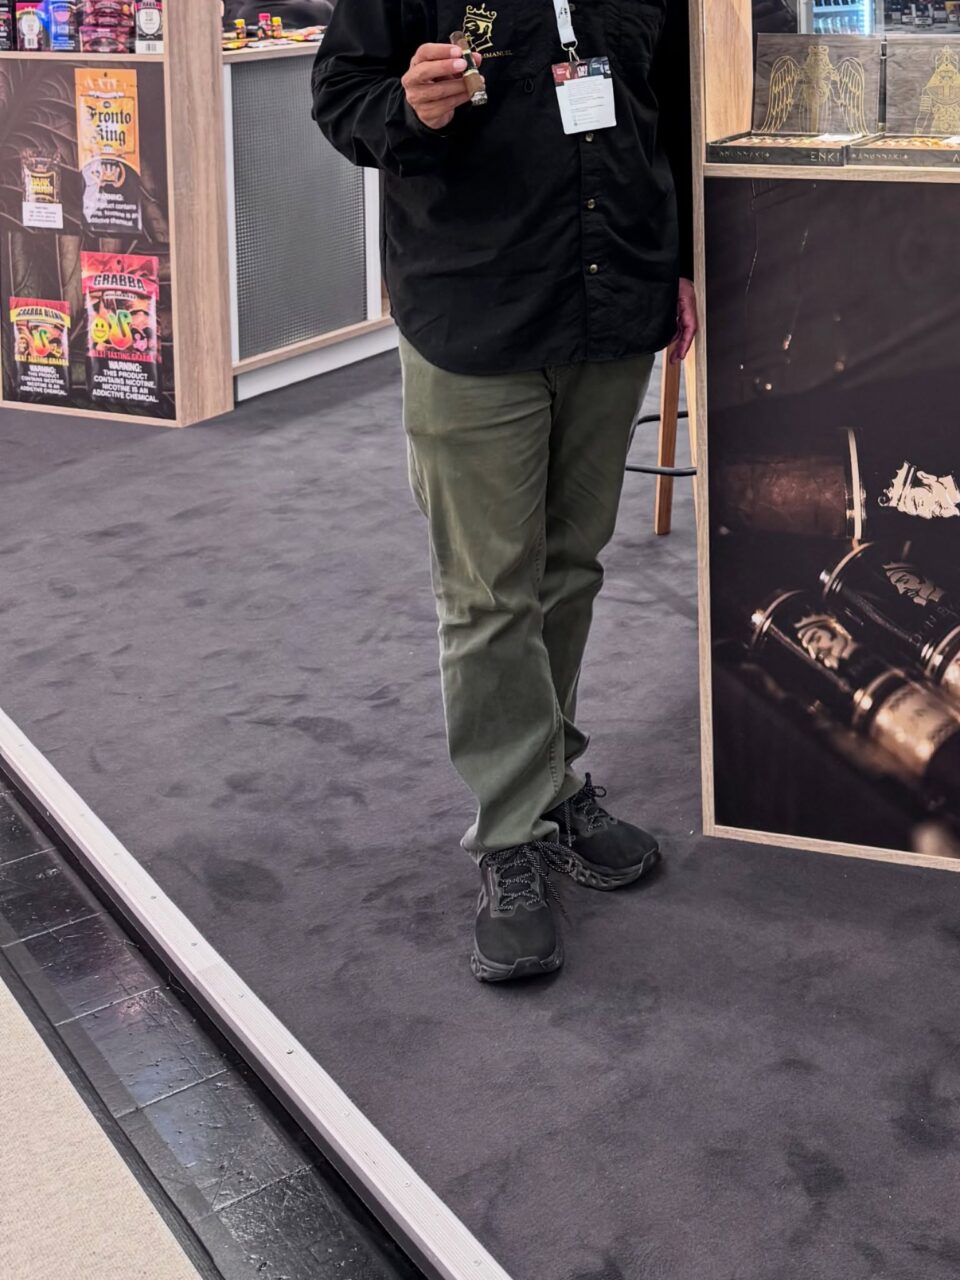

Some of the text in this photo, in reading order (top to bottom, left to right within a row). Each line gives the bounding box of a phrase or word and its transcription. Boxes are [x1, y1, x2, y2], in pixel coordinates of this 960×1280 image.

[85, 105, 132, 125] Fronto
[810, 151, 840, 162] ENKI
[93, 273, 145, 291] GRABBA
[108, 360, 142, 372] WARNING:
[103, 369, 148, 380] THIS PRODUCT
[93, 375, 157, 388] CONTAINS NICOTINE.
[102, 384, 130, 392] NICOTINE
[92, 389, 159, 403] ADDICTIVE CHEMICAL.
